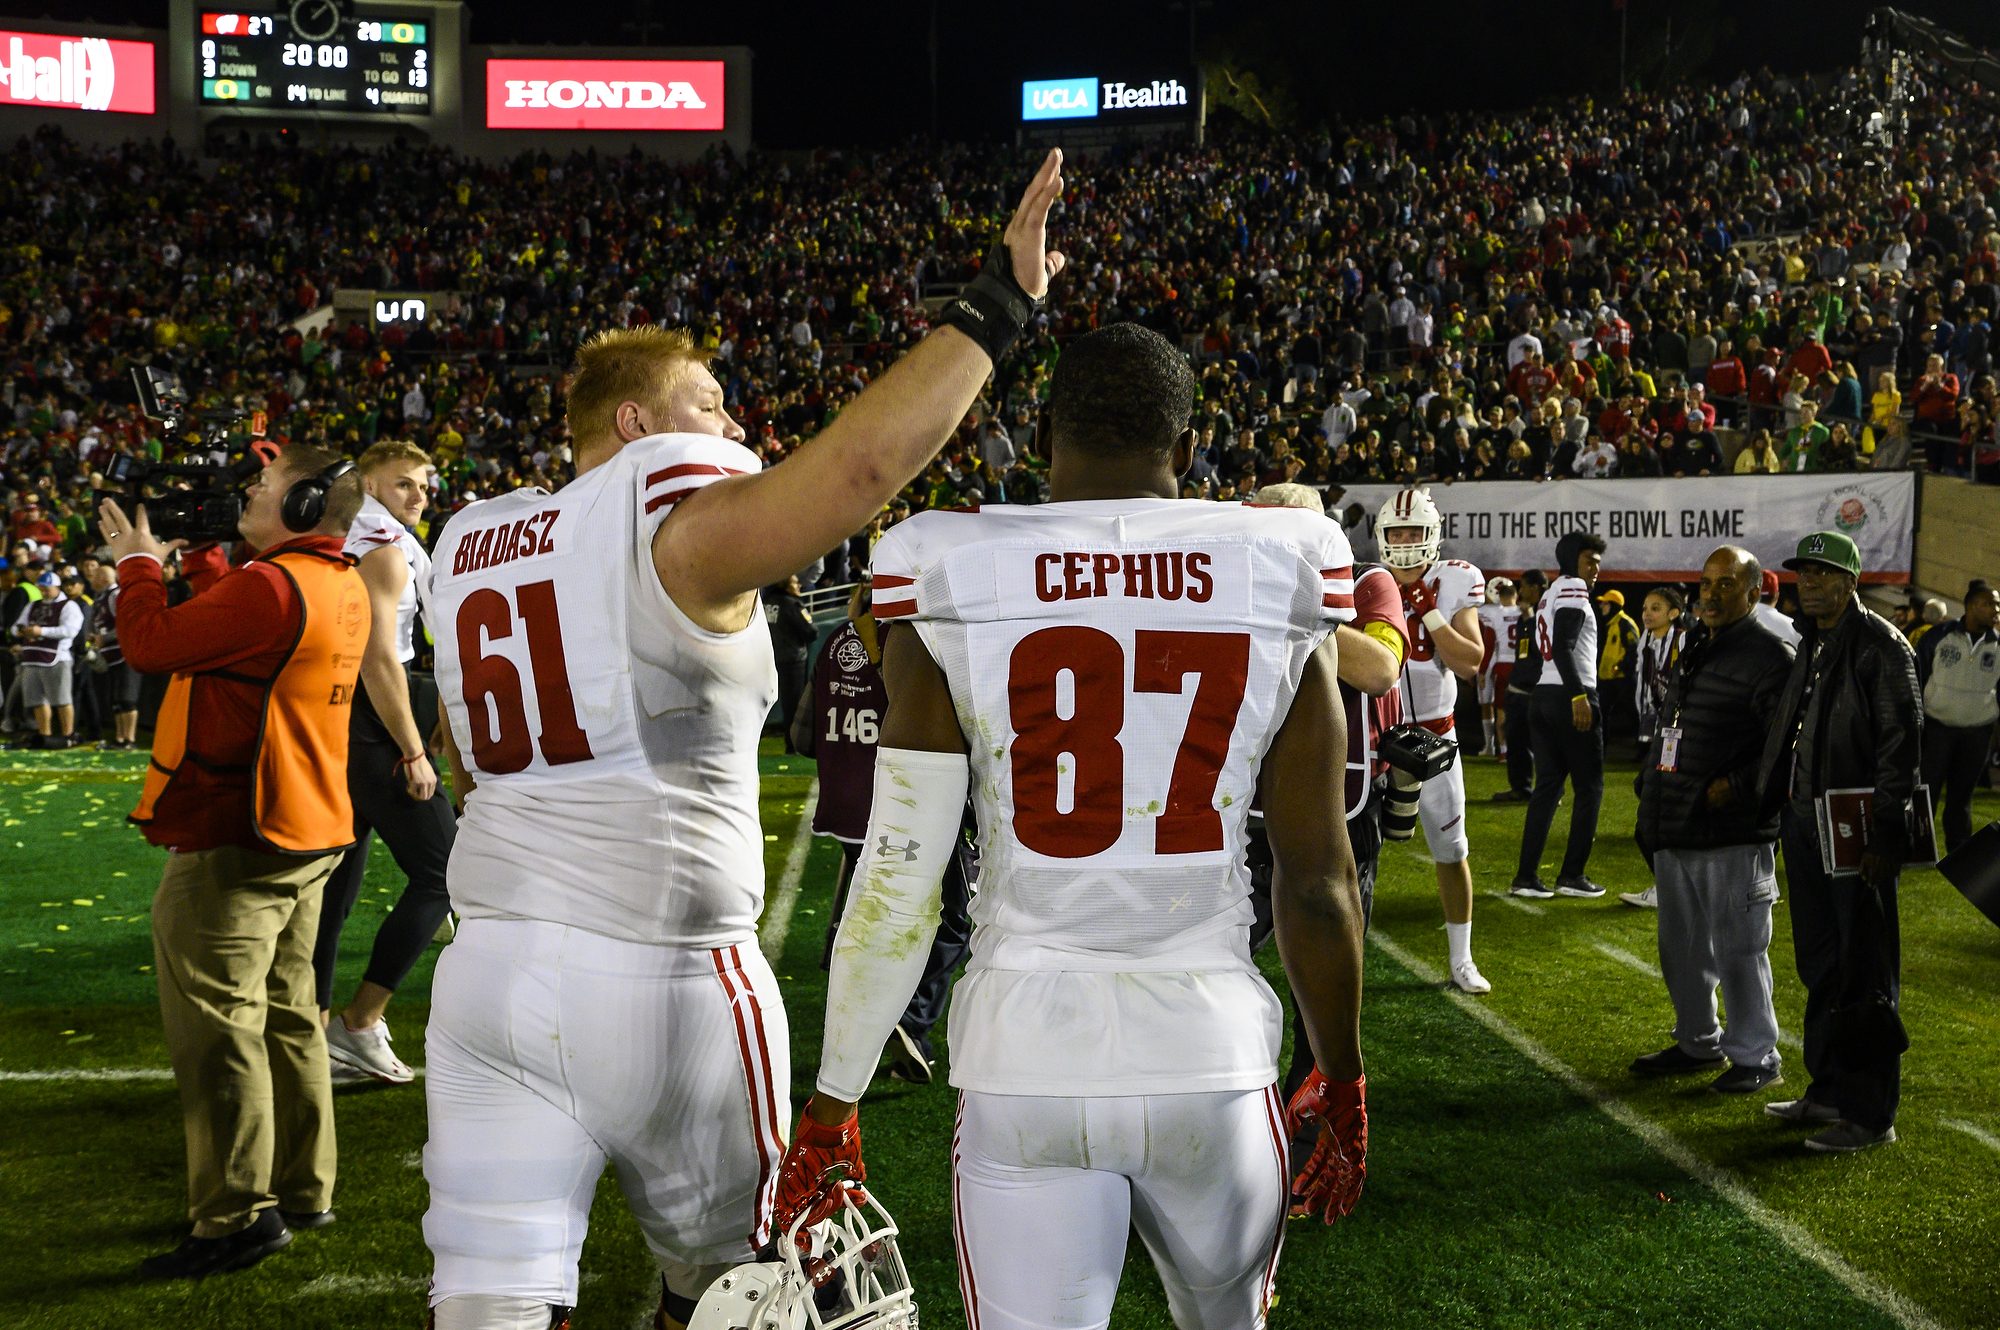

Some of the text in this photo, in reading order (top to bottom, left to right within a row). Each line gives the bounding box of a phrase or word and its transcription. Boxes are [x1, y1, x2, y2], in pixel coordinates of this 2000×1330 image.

[248, 16, 273, 36] 27
[202, 40, 216, 60] 0
[379, 49, 428, 69] TOL 2
[203, 59, 258, 78] 3 DOWN
[364, 68, 428, 88] TO GO 13
[366, 87, 429, 106] 4 QUARTER
[505, 79, 707, 110] HONDA
[1032, 79, 1187, 111] UCLA Health
[1466, 512, 1491, 538] TO
[1498, 512, 1536, 538] THE
[1545, 511, 1601, 539] ROSE
[1609, 509, 1673, 538] BOWL
[1681, 509, 1744, 539] GAME
[452, 509, 561, 577] BIADASZ
[1034, 551, 1214, 603] CEPHUS
[456, 579, 595, 776] 61
[825, 707, 879, 745] 146
[1007, 625, 1251, 859] 87
